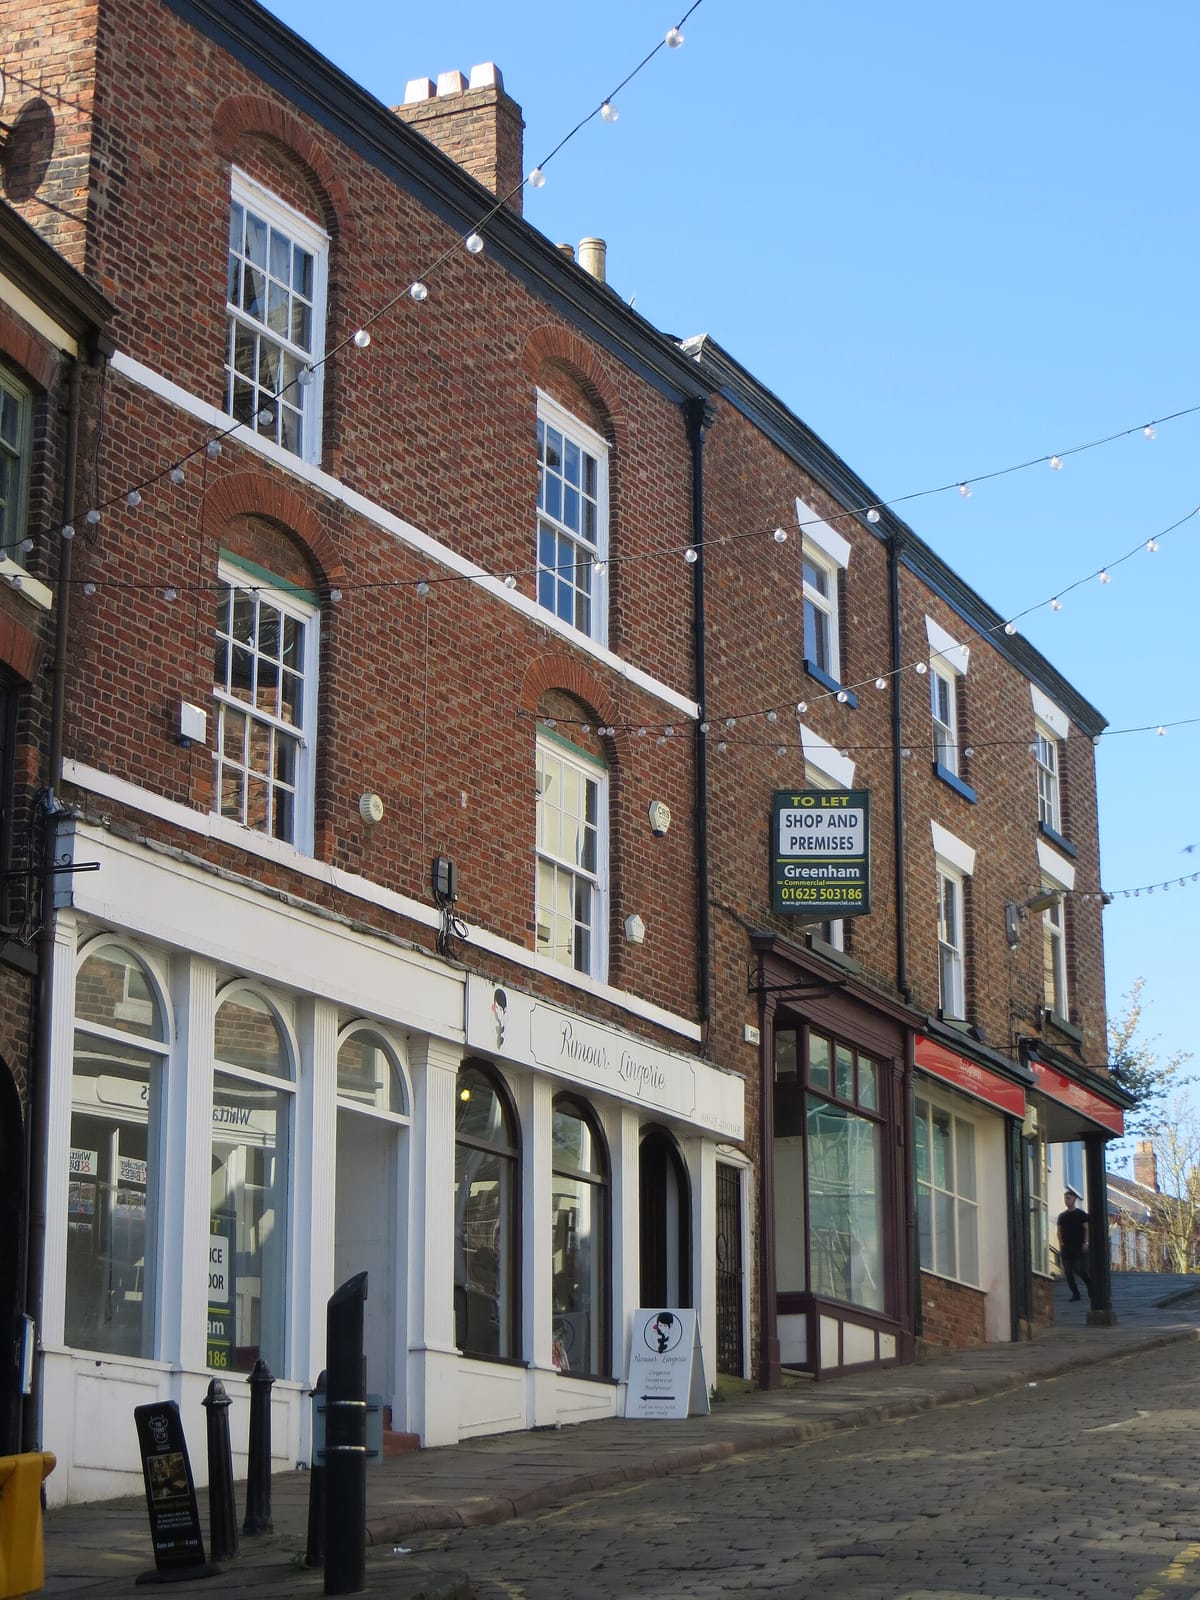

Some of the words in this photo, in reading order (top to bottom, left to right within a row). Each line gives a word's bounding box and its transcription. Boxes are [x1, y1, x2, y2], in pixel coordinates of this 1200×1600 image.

[791, 796, 815, 807] TO
[821, 796, 849, 807] LET
[785, 814, 823, 828] SHOP
[827, 814, 858, 828] AND
[790, 836, 854, 850] PREMISES
[784, 865, 860, 878] Greenham
[781, 888, 817, 900] 01625
[819, 888, 862, 900] 503186
[618, 1050, 665, 1096] Lingerie
[208, 1350, 227, 1367] 186
